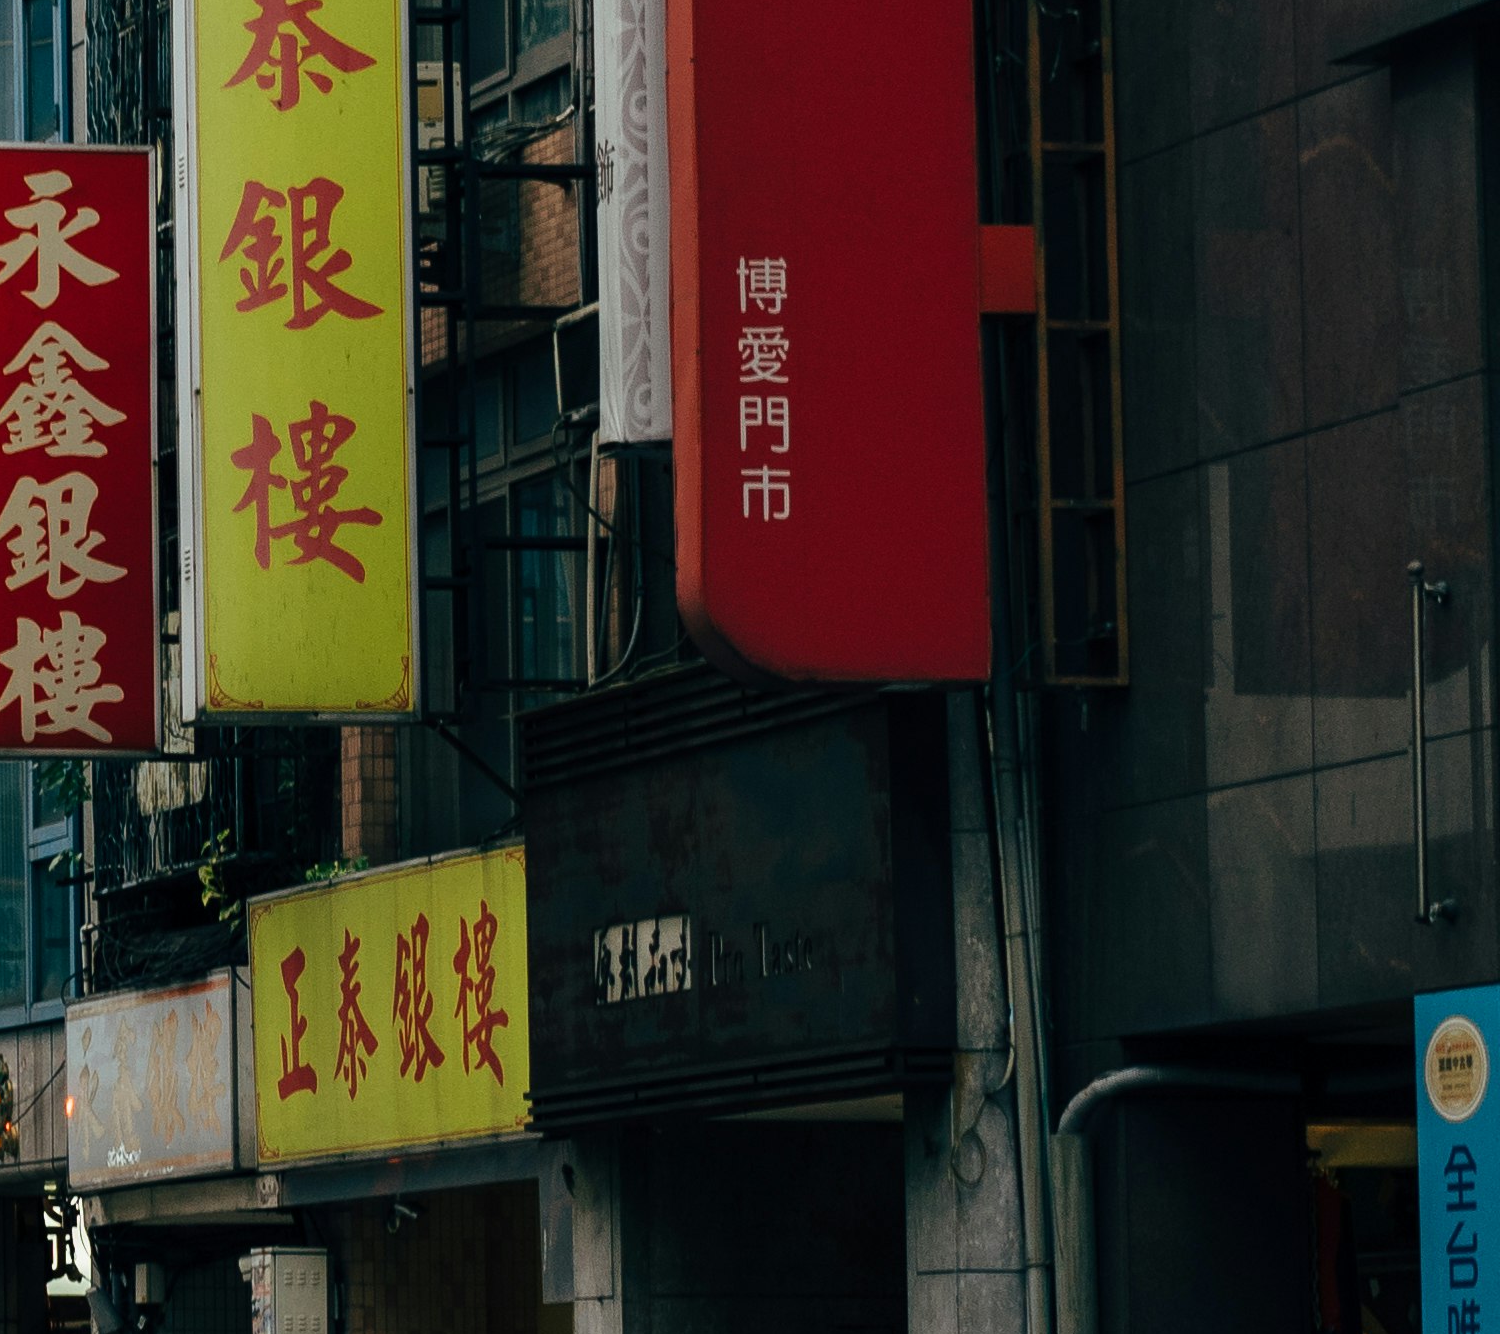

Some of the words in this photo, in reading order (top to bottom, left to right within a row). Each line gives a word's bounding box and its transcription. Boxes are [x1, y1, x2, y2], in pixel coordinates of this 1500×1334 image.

[734, 253, 791, 525] 博愛門市
[278, 898, 510, 1103] 正泰銀樓
